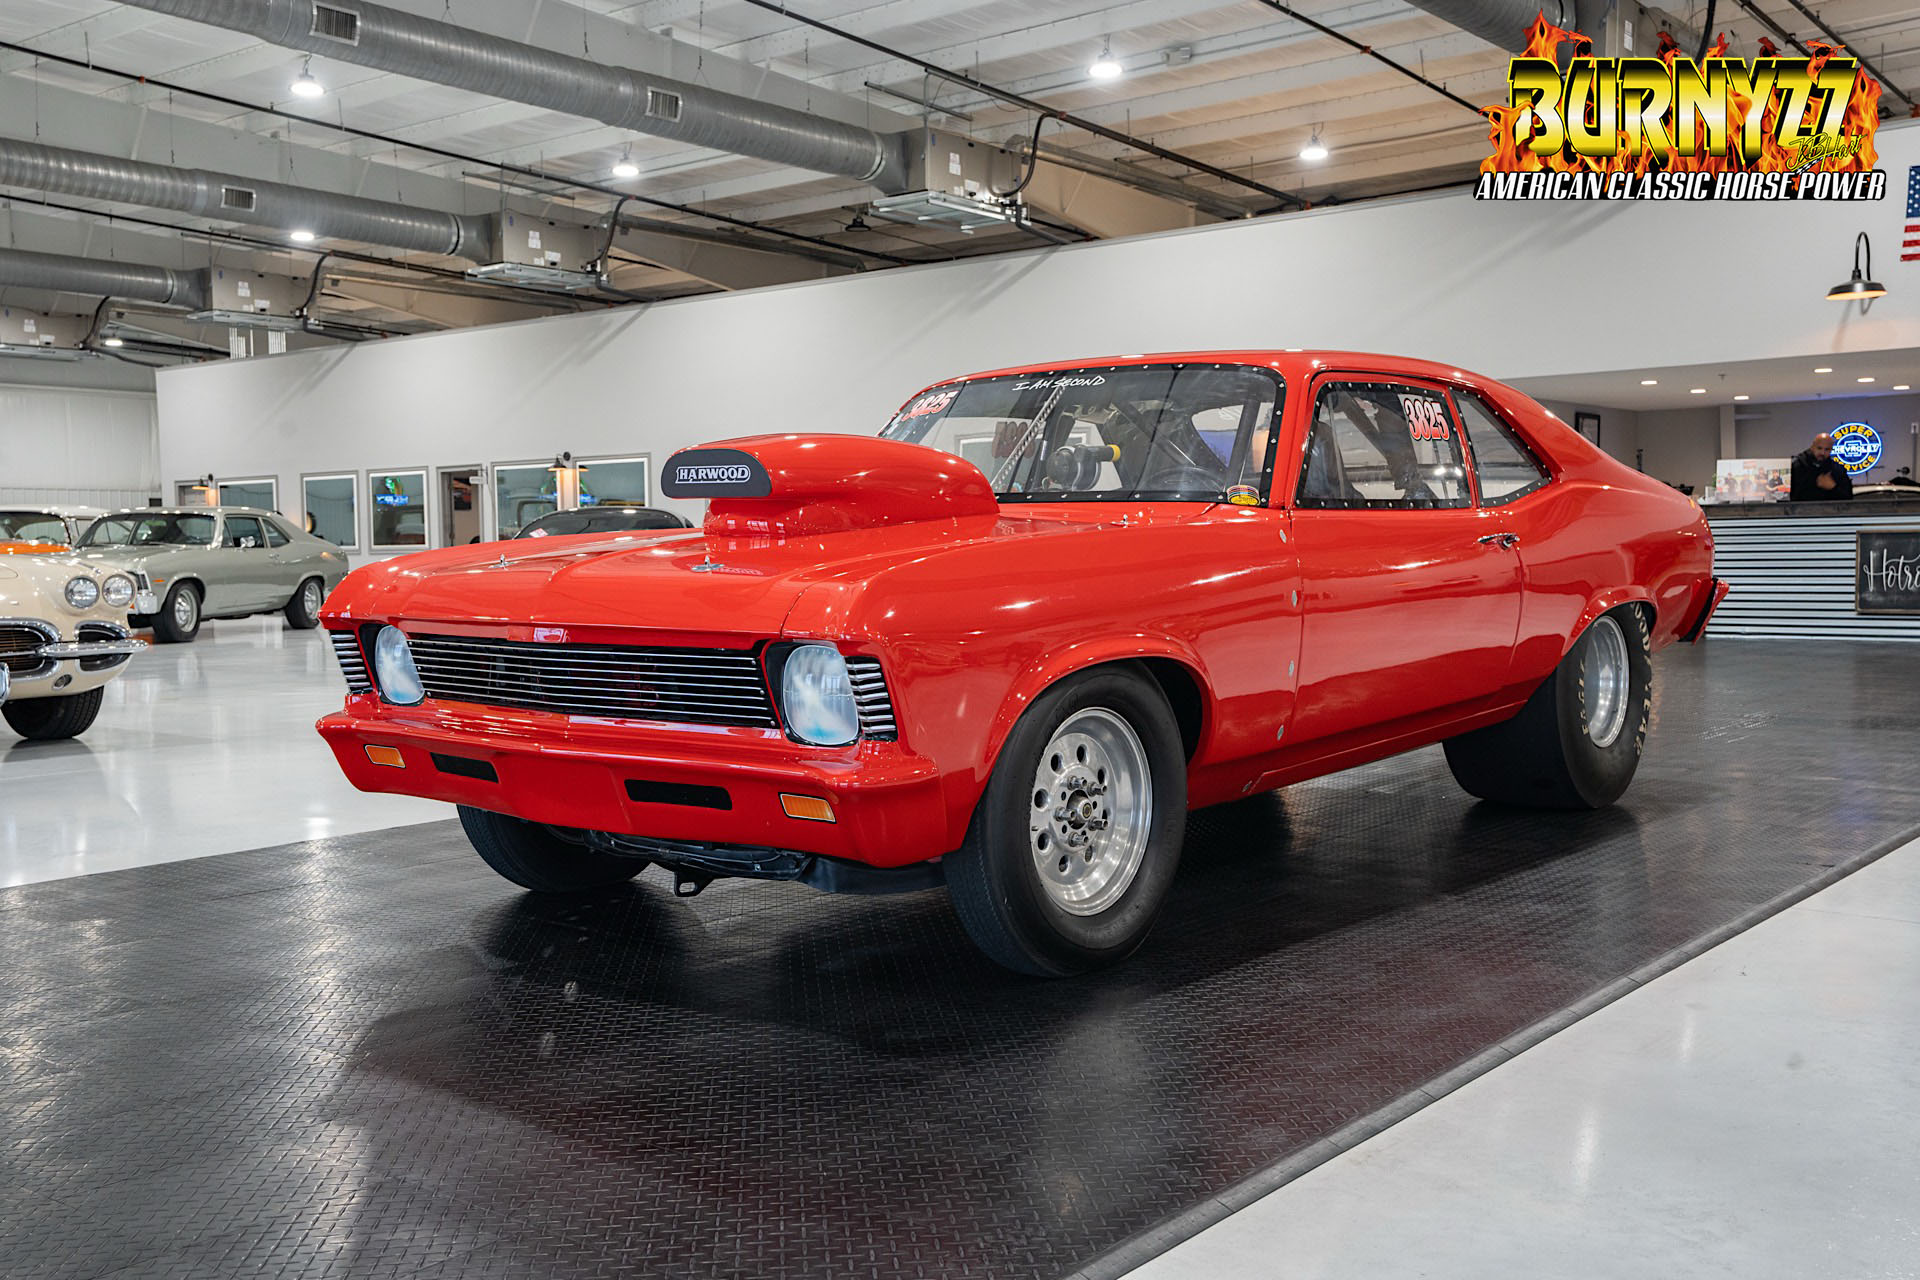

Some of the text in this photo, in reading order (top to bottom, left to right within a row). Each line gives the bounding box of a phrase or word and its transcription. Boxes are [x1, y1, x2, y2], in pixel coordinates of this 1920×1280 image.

[1012, 375, 1106, 391] I AM SECOND
[1404, 398, 1450, 441] 3825
[1833, 425, 1873, 440] SUPER
[679, 467, 749, 480] HARWOOD
